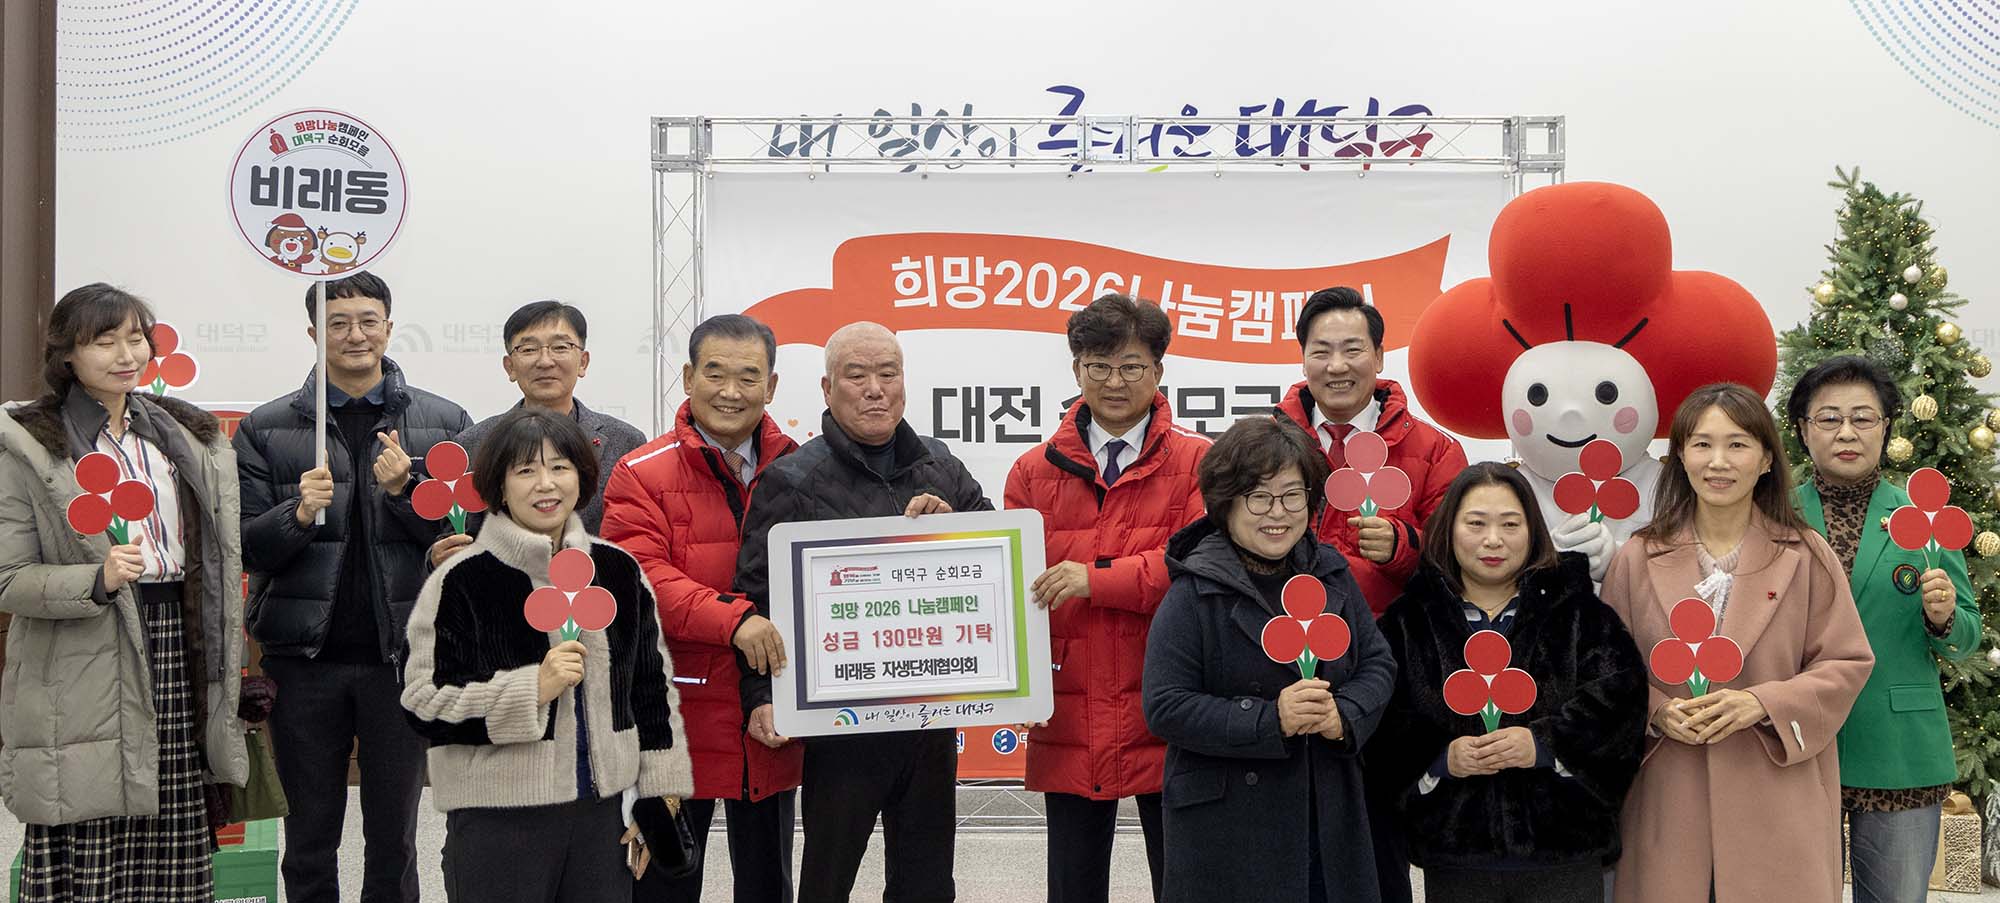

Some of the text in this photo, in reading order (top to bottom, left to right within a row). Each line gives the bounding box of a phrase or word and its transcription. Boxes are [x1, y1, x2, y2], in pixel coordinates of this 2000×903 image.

[292, 133, 325, 147] 대덕구
[294, 119, 370, 143] 희망나눔캠페인
[250, 165, 389, 215] 비래동
[197, 322, 267, 343] 대덕구
[932, 386, 1042, 443] 대전
[891, 564, 983, 583] 대덕구 순회모금
[831, 595, 979, 620] 희망 2026 나눔캠페인
[823, 623, 993, 652] 성금 130만원 기탁
[834, 656, 979, 681] 비래동 자생단체협의회
[956, 702, 995, 717] 대덕구
